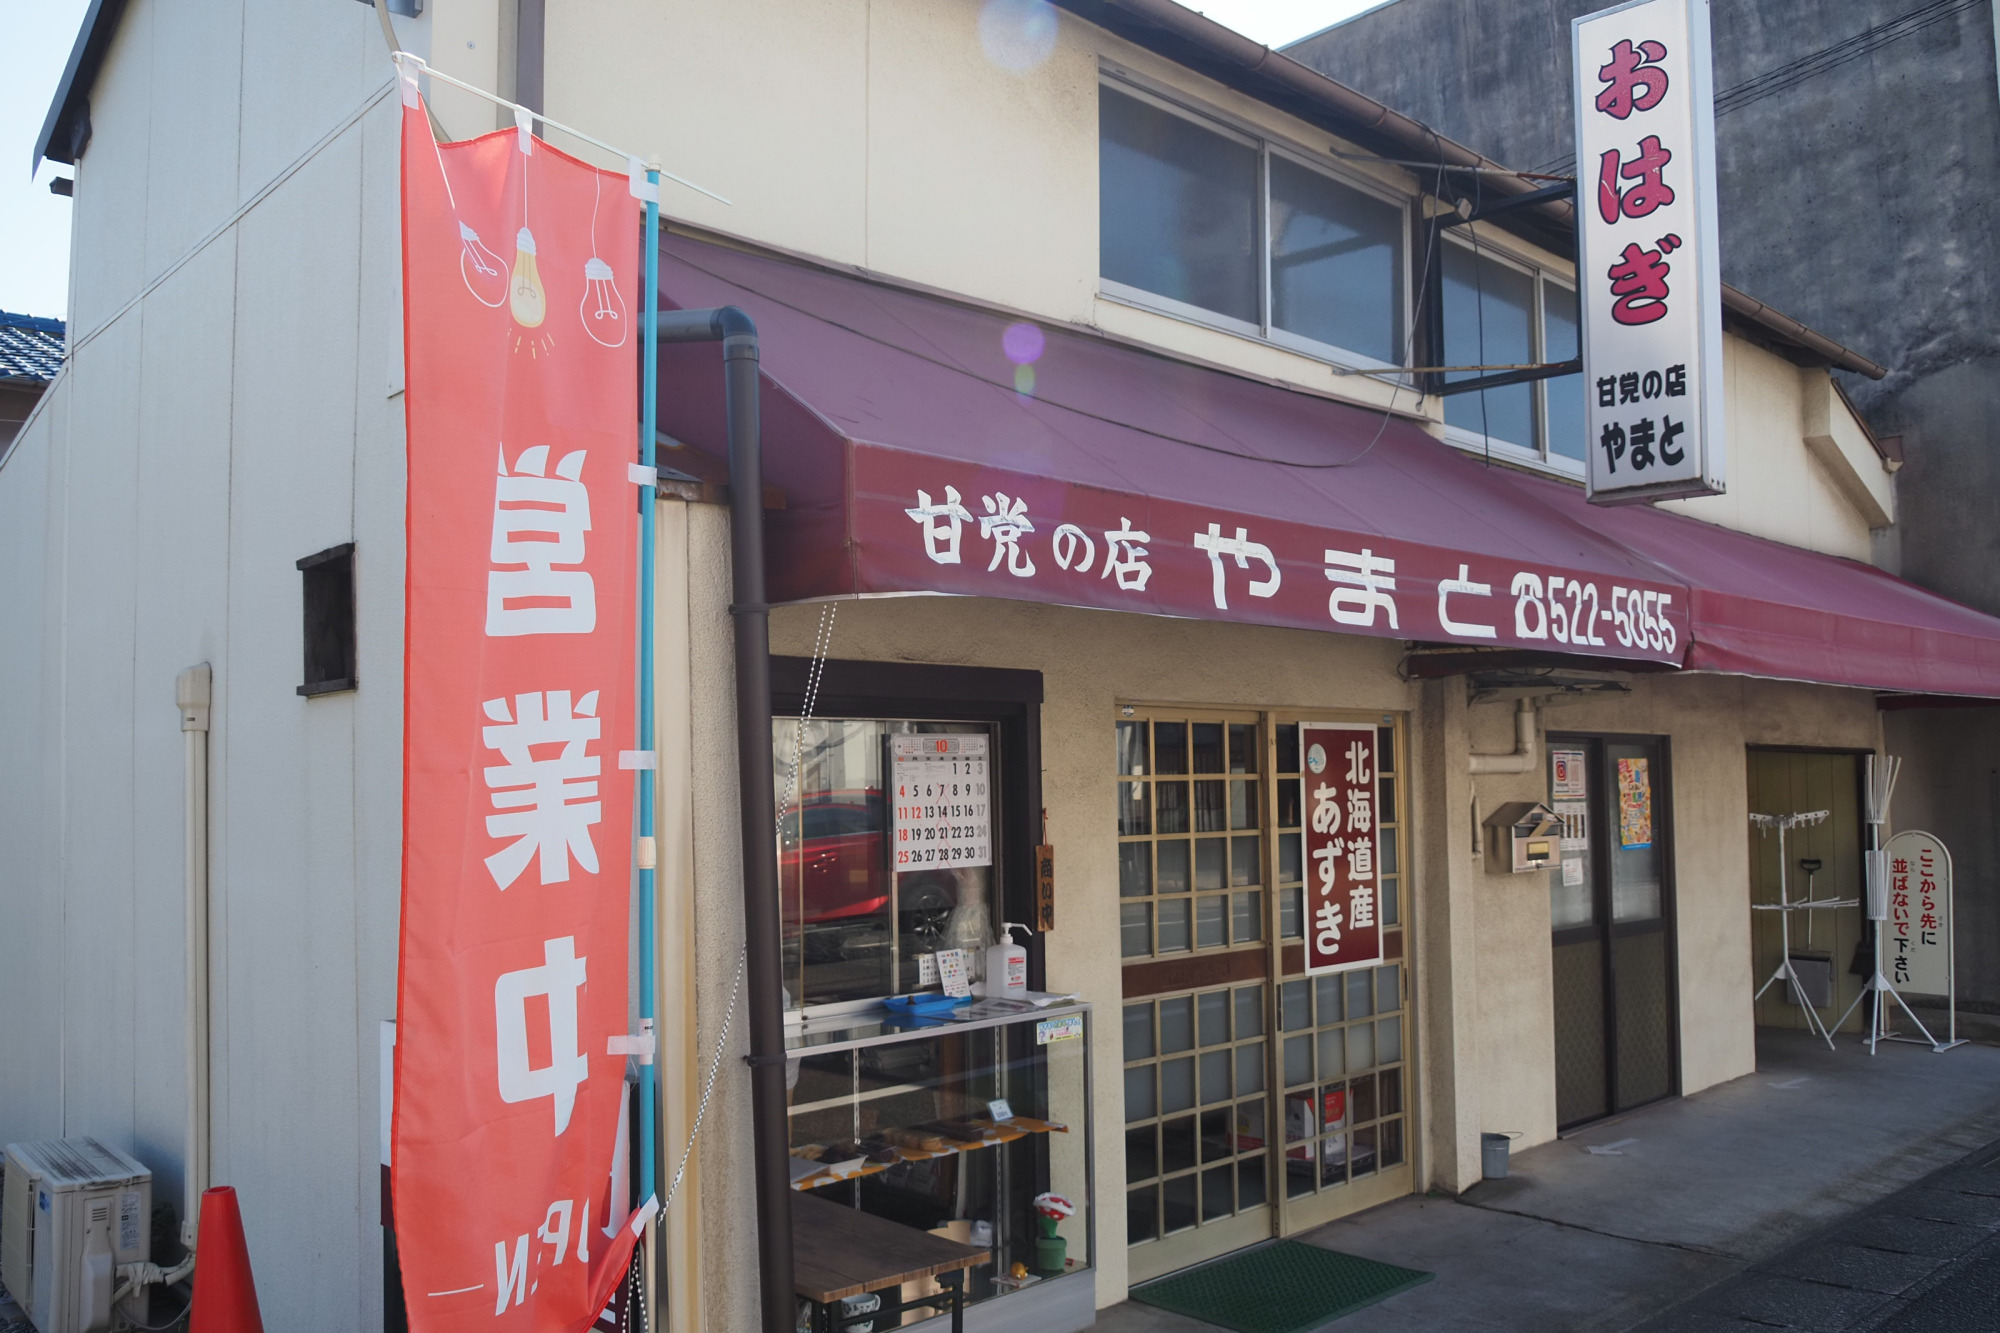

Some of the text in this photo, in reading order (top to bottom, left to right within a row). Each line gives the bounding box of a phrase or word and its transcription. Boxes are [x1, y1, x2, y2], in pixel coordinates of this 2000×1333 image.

[1595, 39, 1682, 326] おはぎ
[1596, 364, 1686, 407] 甘党の店
[1600, 414, 1684, 474] やまと
[905, 485, 1676, 654] 甘党の店 やまと 522-5055
[936, 740, 948, 753] 10
[953, 763, 957, 775] 1
[965, 763, 971, 775] 2
[898, 804, 986, 819] 11 12 13 14 15 16 17
[899, 785, 905, 797] 4
[913, 785, 919, 797] 5
[926, 784, 932, 797] 6
[952, 784, 958, 796] 8
[965, 784, 970, 796] 9
[976, 783, 986, 796] 10
[898, 829, 908, 841] 18
[911, 828, 921, 841] 19
[924, 828, 935, 840] 20
[938, 827, 948, 839] 21
[951, 826, 962, 839] 22
[964, 826, 974, 838] 23
[898, 851, 909, 863] 25
[911, 850, 922, 863] 26
[925, 849, 936, 861] 27
[938, 848, 949, 861] 28
[951, 848, 962, 860] 29
[964, 847, 975, 859] 30
[1345, 741, 1374, 930] 北海道産
[1312, 781, 1344, 955] あずき
[1892, 858, 1910, 984] 並ばないで下さい
[1920, 849, 1937, 945] ここから先に
